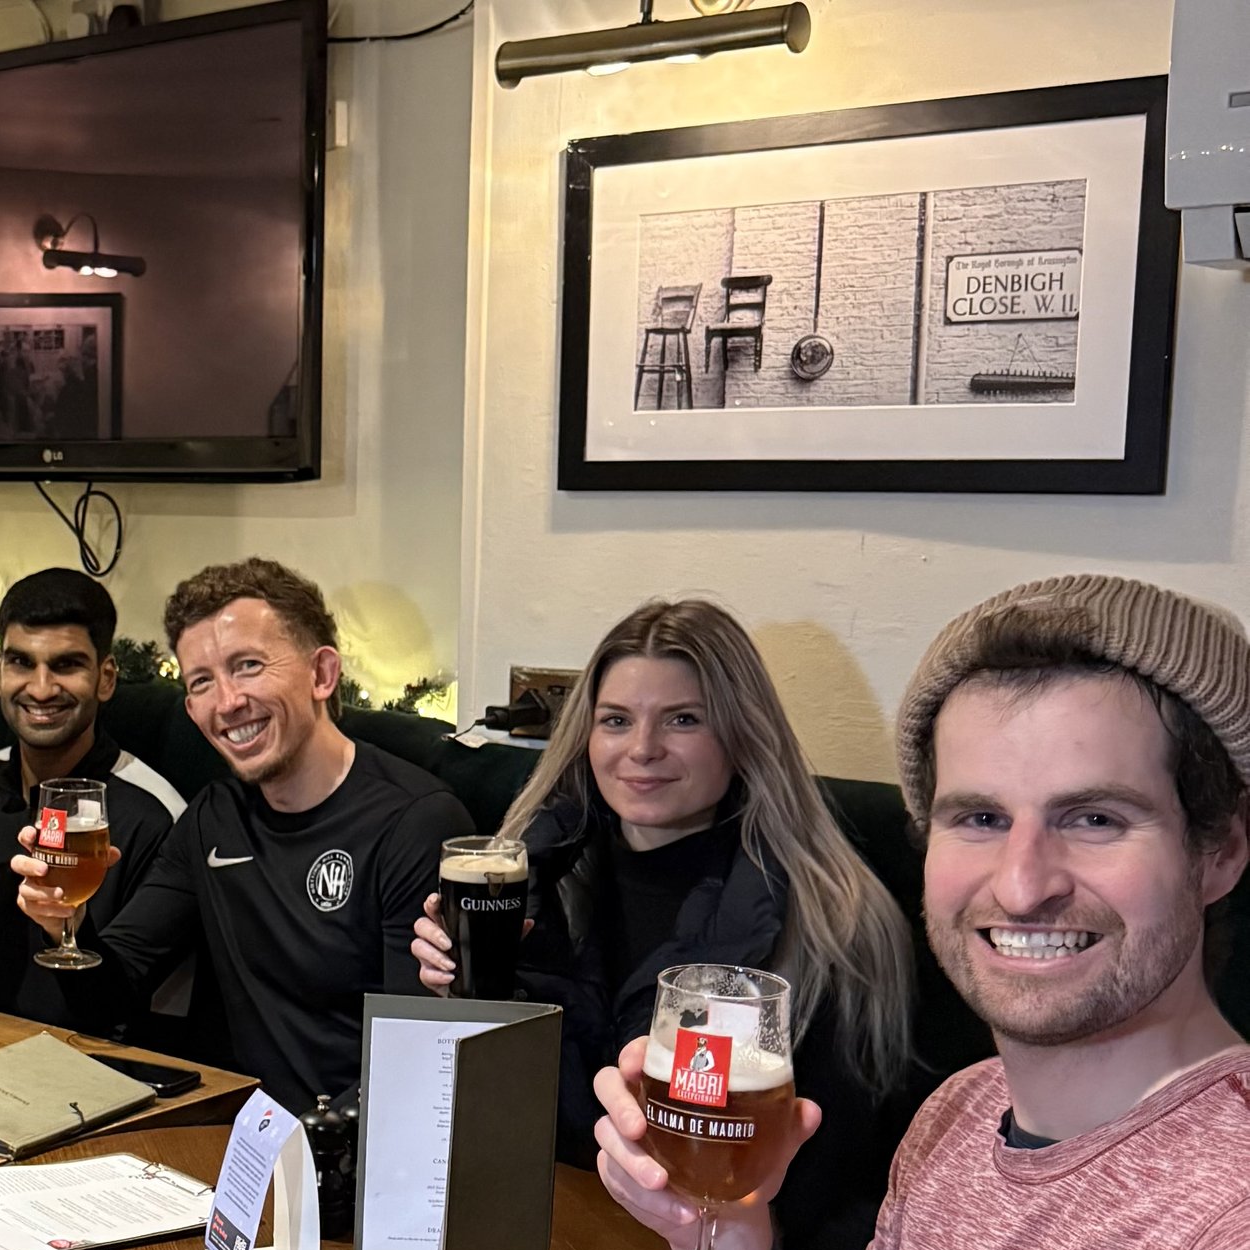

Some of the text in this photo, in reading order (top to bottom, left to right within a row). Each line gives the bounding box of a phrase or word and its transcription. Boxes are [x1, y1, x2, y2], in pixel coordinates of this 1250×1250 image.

[966, 272, 1064, 295] DENBIGH
[460, 897, 521, 911] GUINNESS
[646, 1105, 755, 1138] EL ALMA DE MADRID
